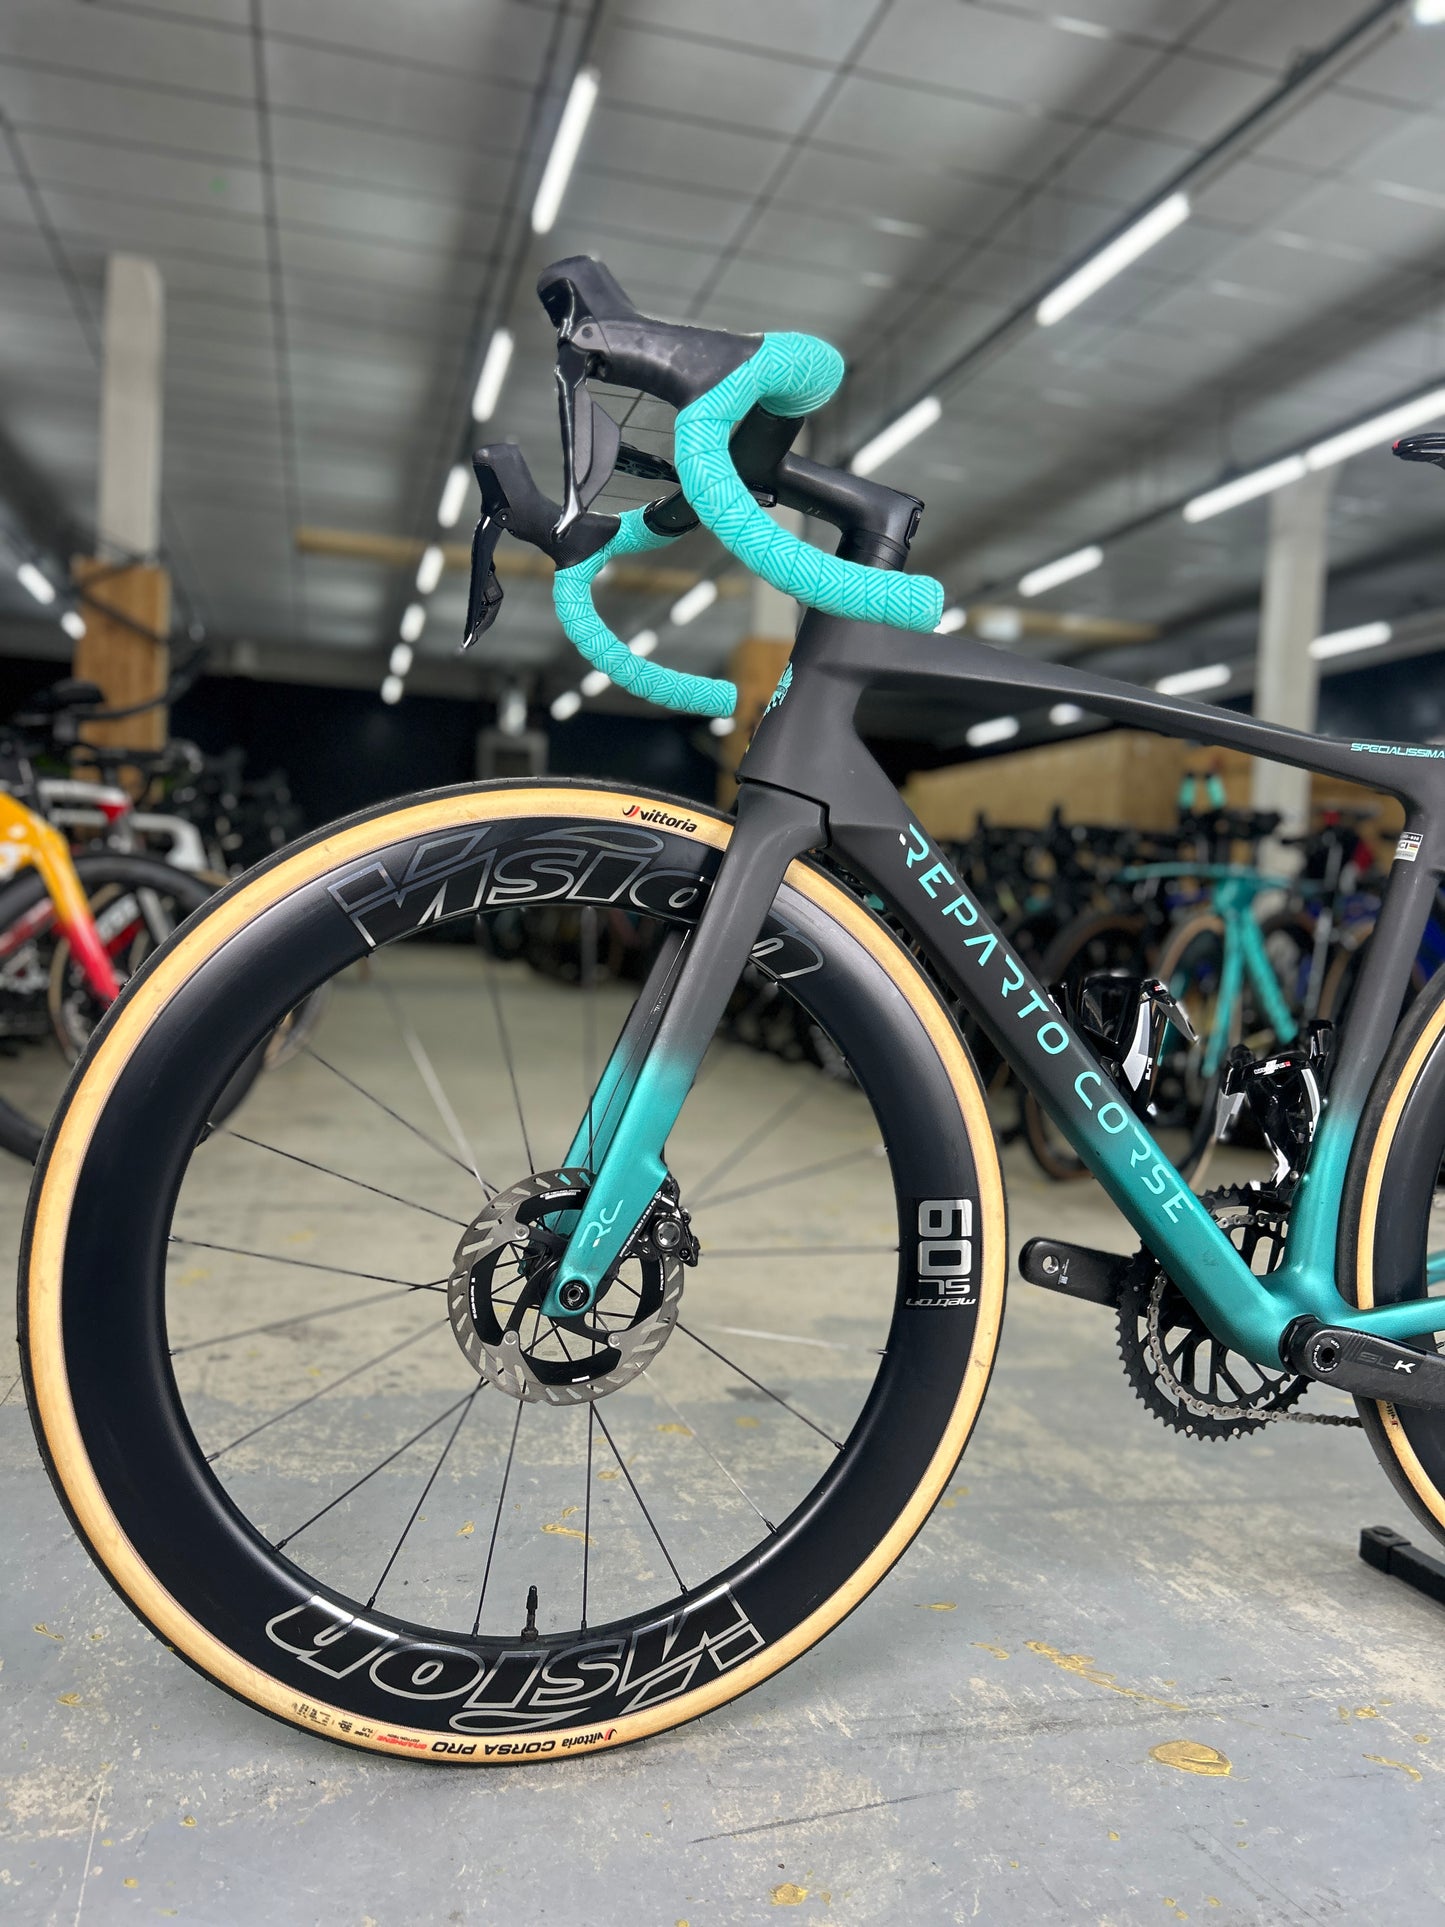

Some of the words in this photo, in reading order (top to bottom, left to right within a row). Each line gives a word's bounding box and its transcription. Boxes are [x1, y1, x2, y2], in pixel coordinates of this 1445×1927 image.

[1350, 742, 1445, 759] SPECIALISSIMA
[640, 809, 698, 832] vittoria
[900, 823, 1070, 1056] REPARTO
[1074, 1070, 1195, 1224] CORSE
[918, 1199, 972, 1276] 60
[918, 1278, 970, 1295] SL
[431, 1741, 478, 1756] PRO
[484, 1740, 556, 1756] CORSA
[562, 1732, 604, 1748] vittoria
